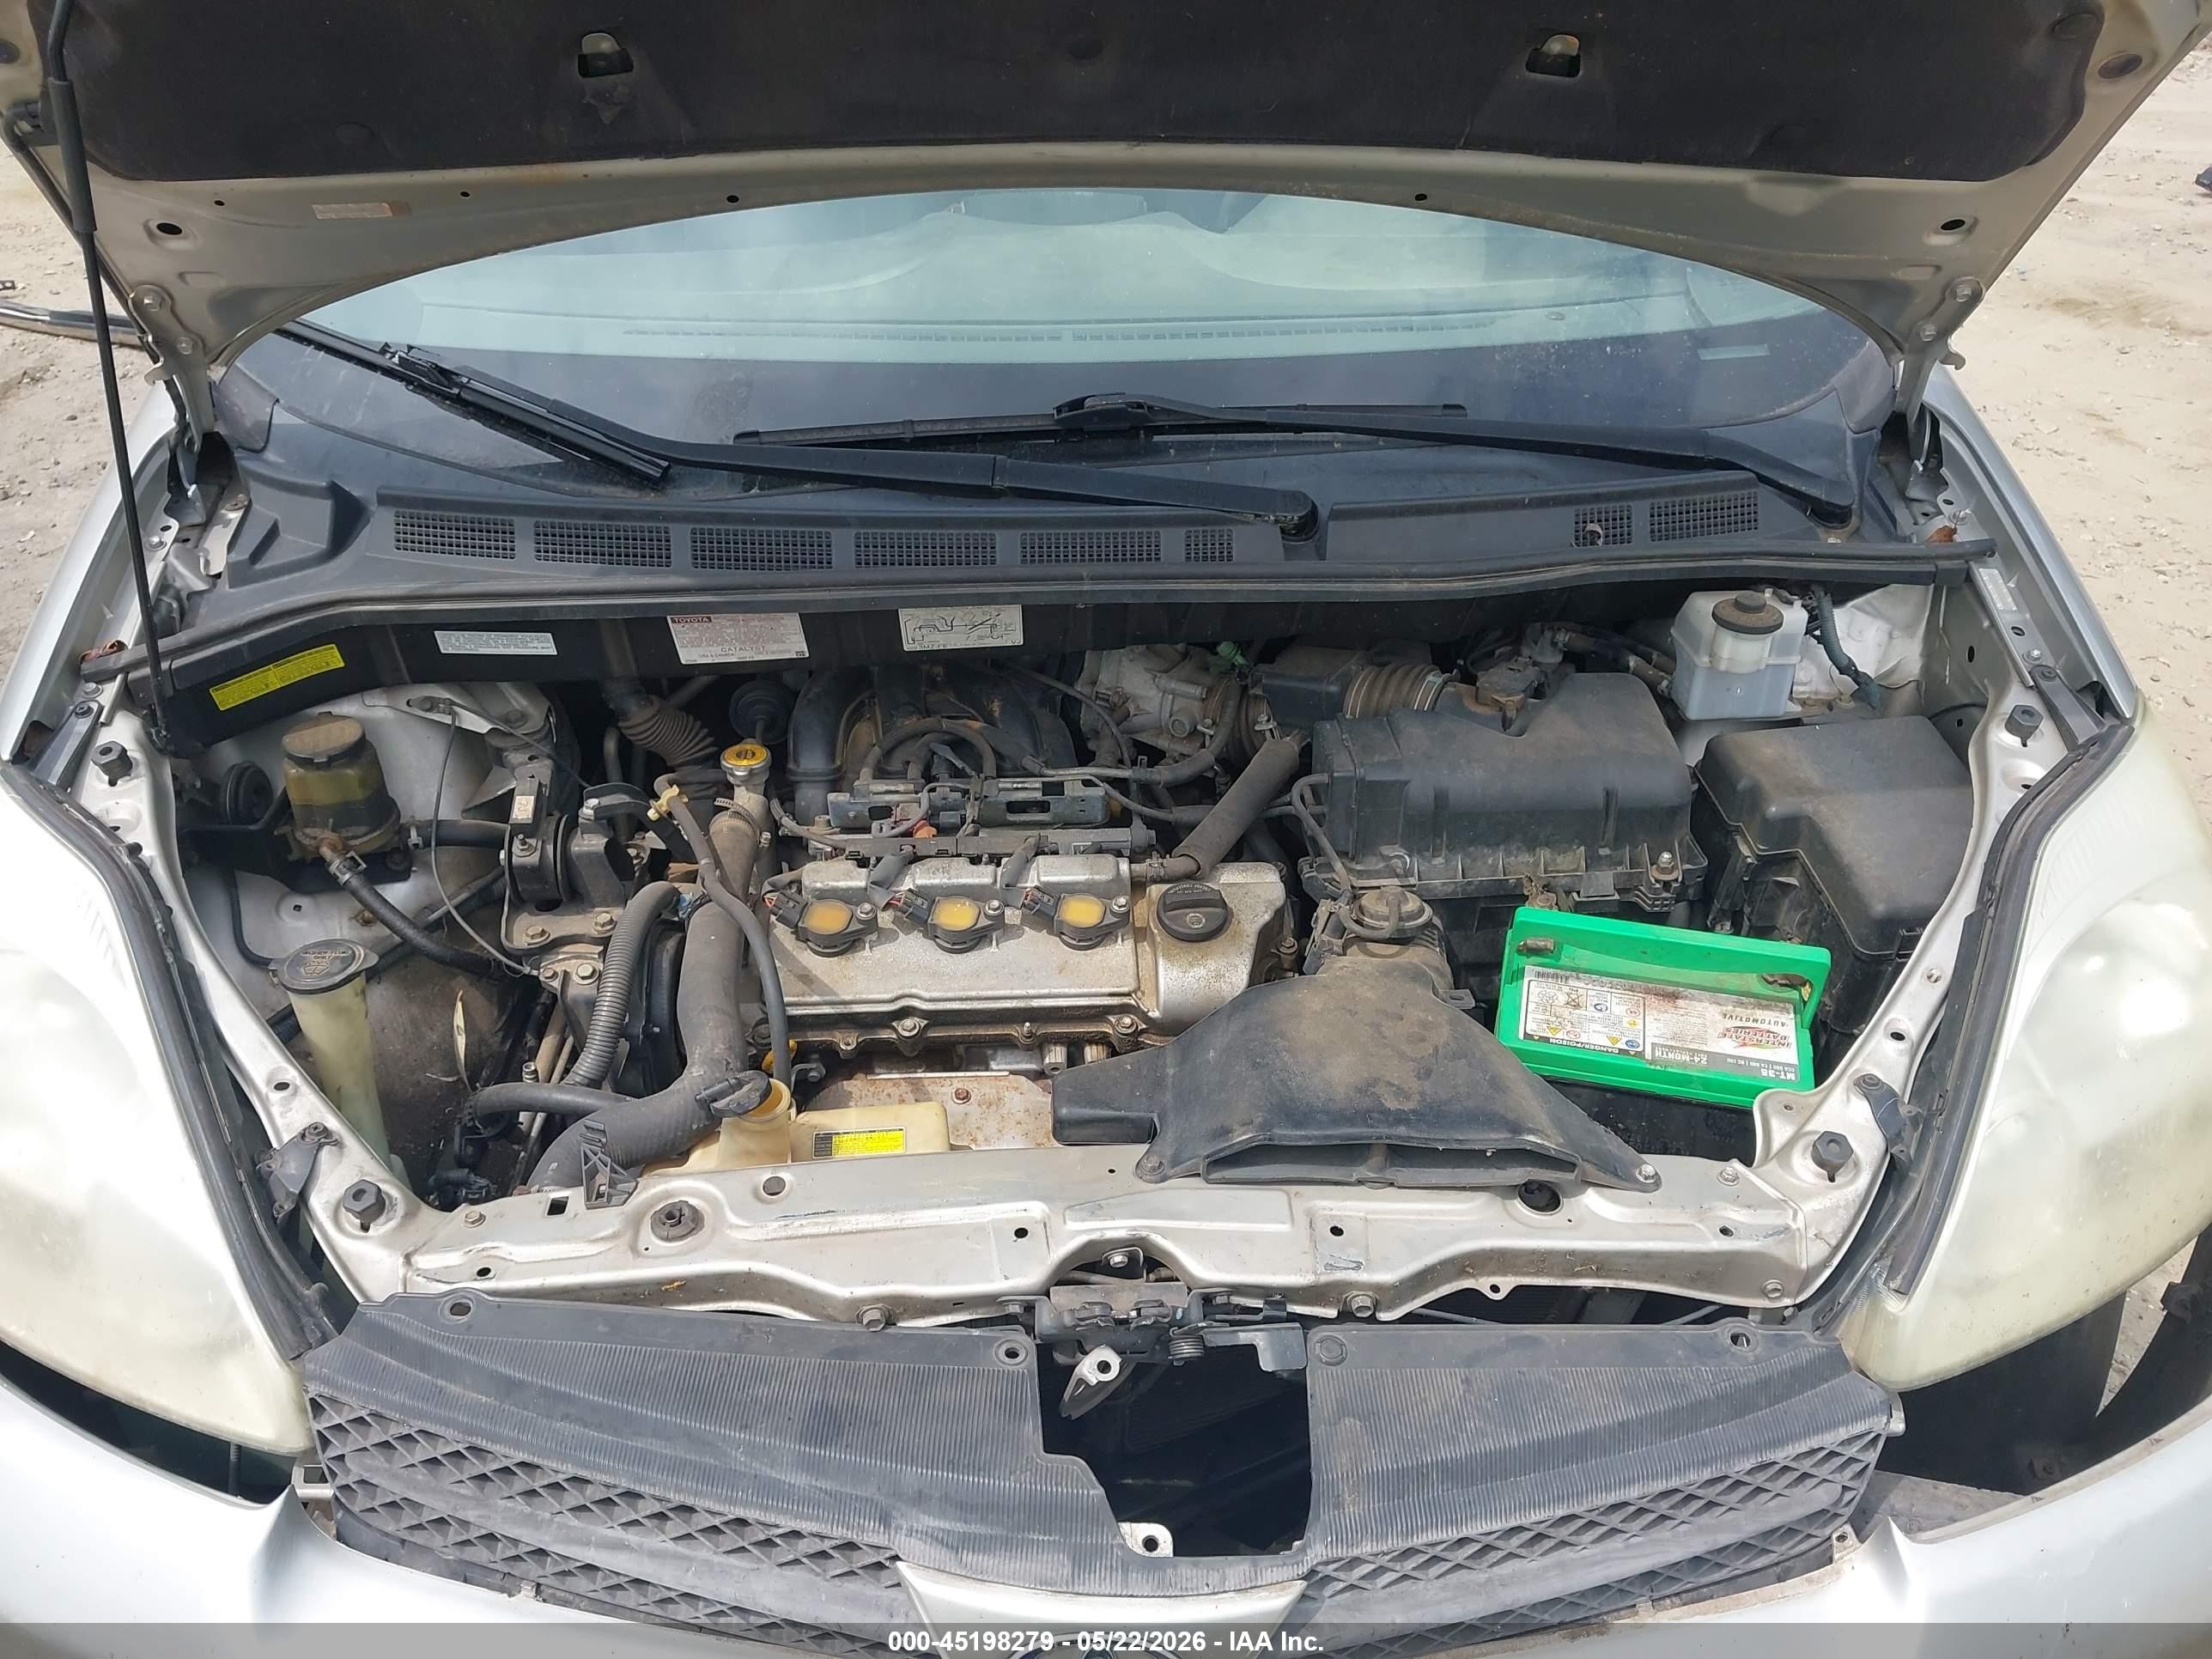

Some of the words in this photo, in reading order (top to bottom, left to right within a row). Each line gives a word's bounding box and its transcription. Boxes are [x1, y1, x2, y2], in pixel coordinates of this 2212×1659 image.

[1722, 1013, 1787, 1027] AUTOMOTIVE
[1717, 1032, 1792, 1049] INTERSTATE
[1722, 1027, 1790, 1041] BATTERIES
[1549, 1038, 1620, 1054] DANGER/POISON
[1655, 1048, 1708, 1065] 24-MONTH
[1760, 1067, 1796, 1080] MT-35
